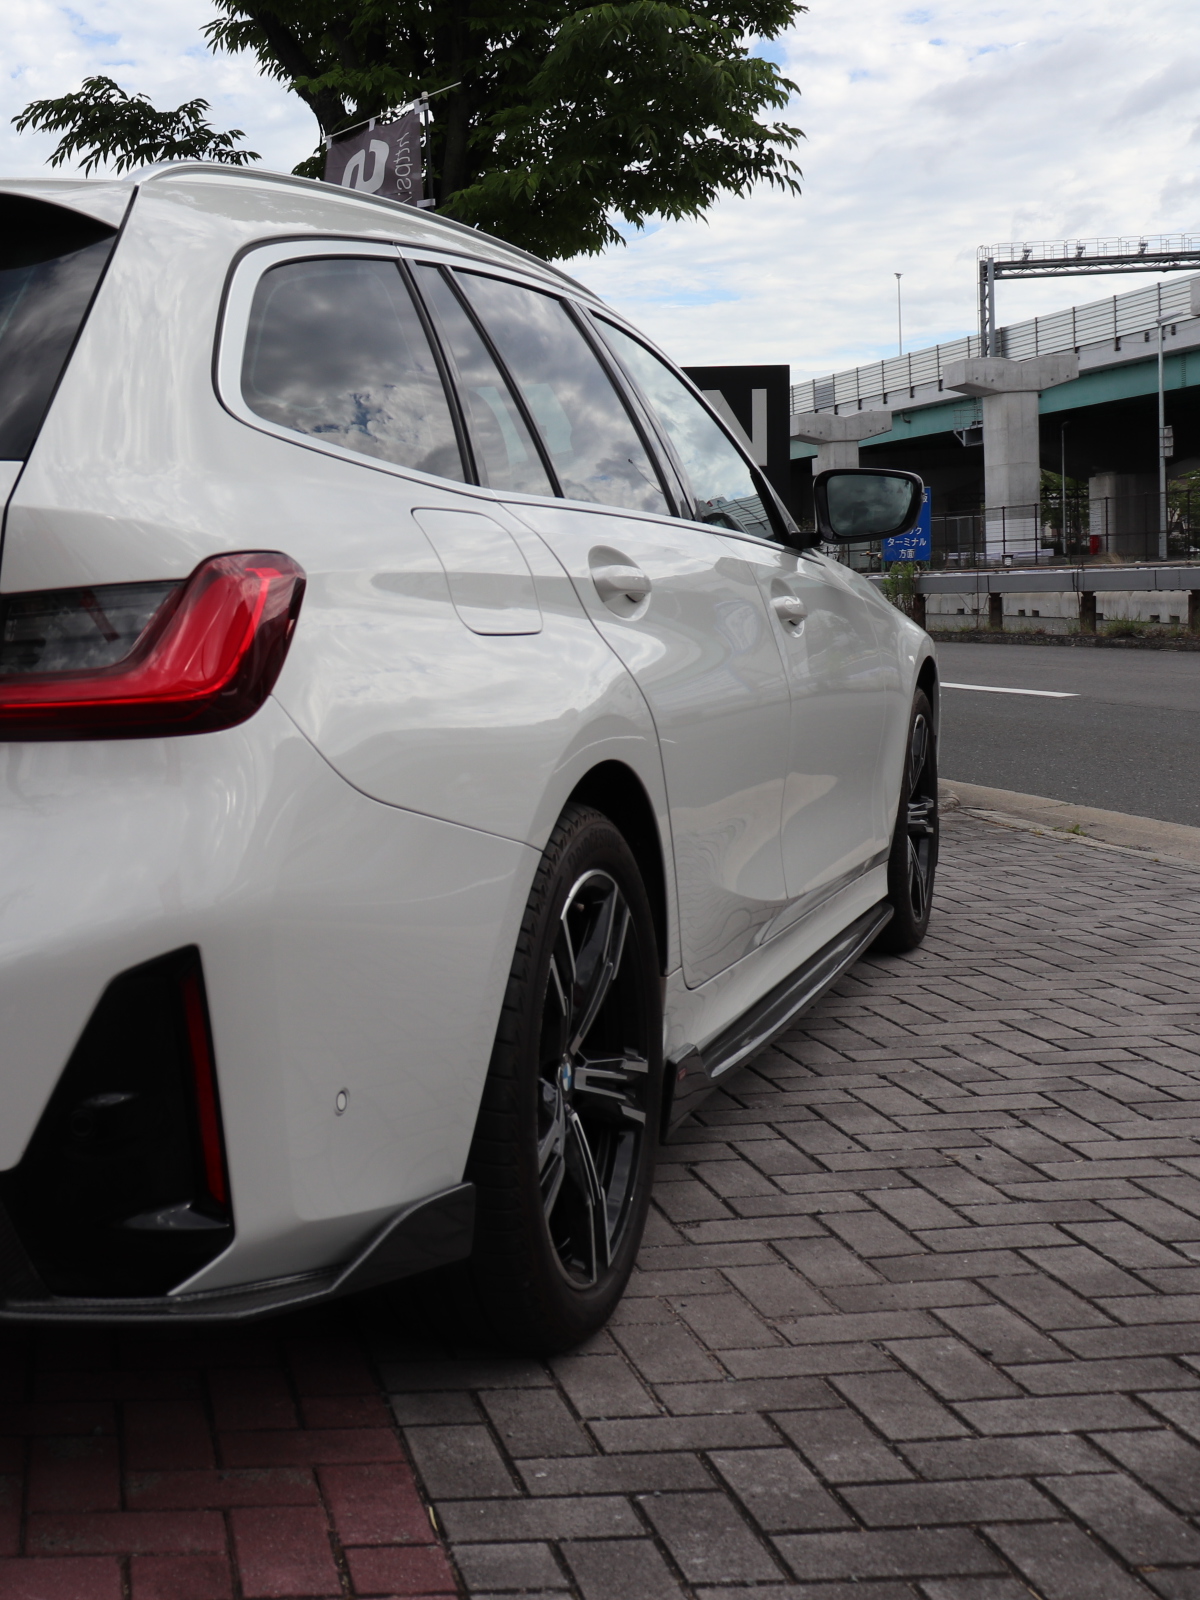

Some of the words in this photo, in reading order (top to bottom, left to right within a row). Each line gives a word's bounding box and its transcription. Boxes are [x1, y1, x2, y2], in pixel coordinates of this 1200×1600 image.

[887, 537, 927, 547] ターミナル
[898, 548, 915, 559] 方面
